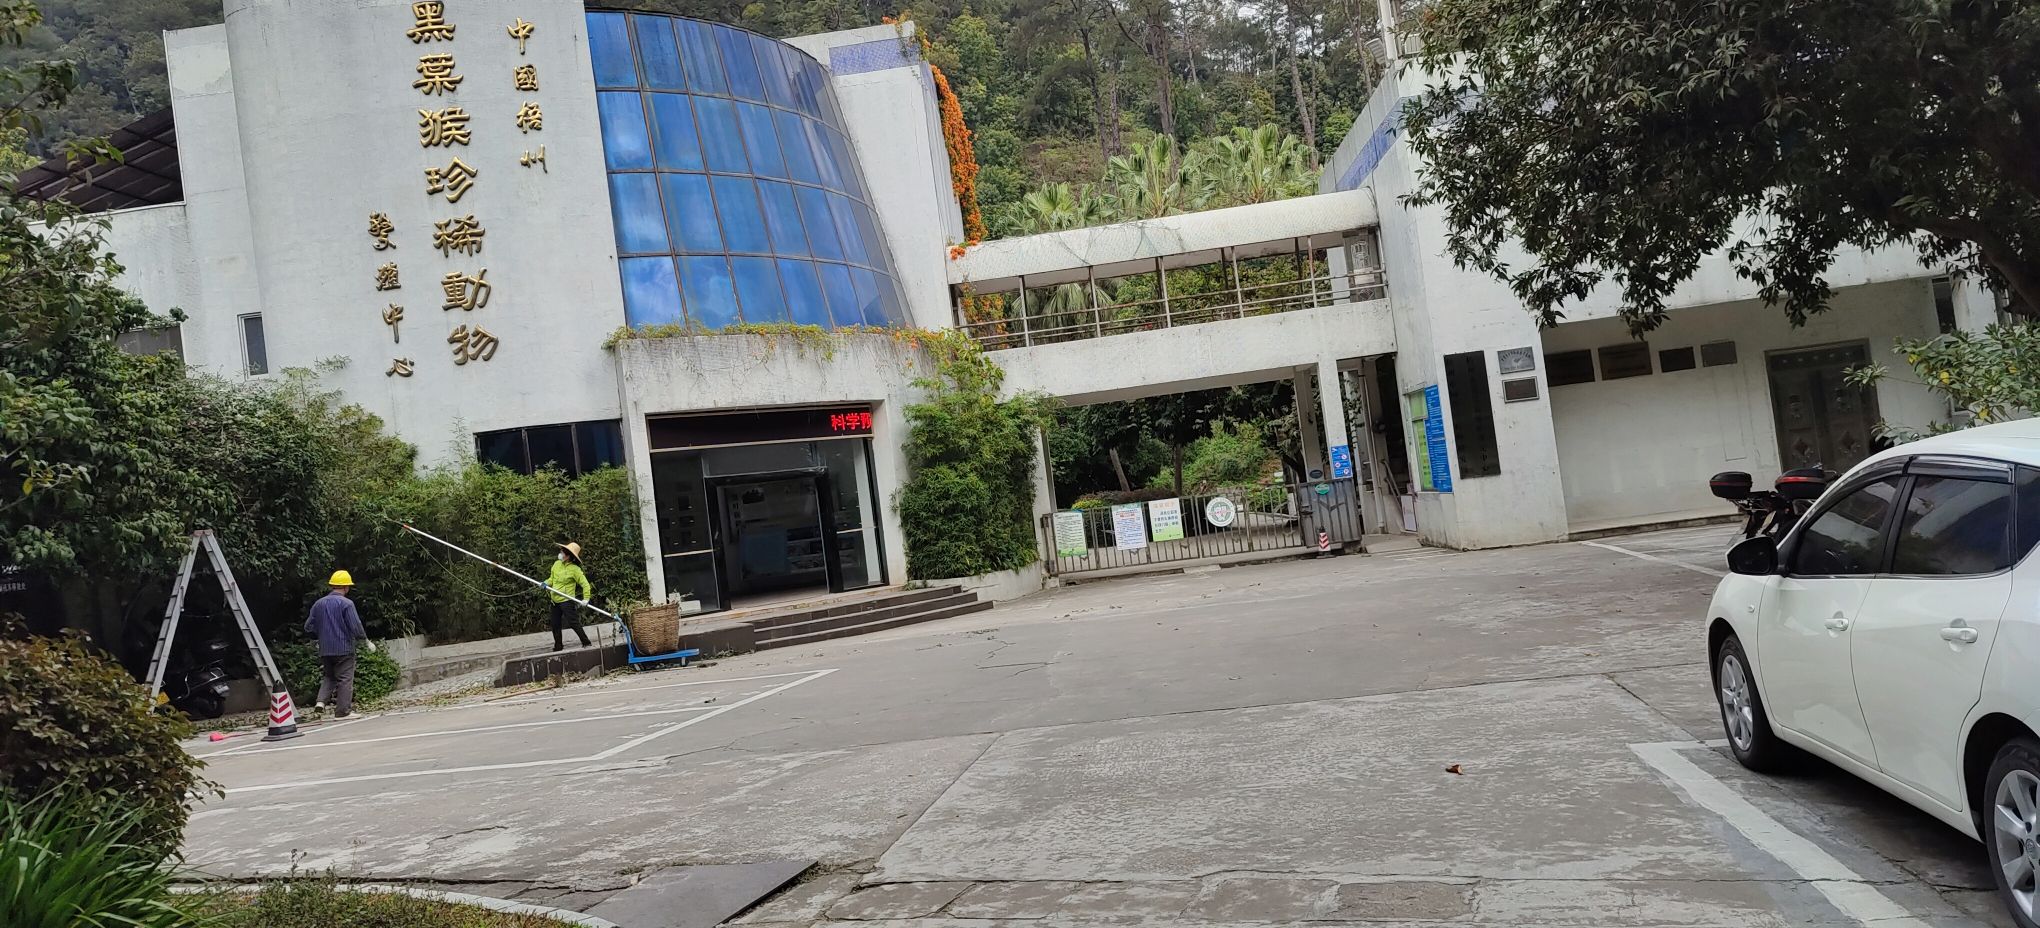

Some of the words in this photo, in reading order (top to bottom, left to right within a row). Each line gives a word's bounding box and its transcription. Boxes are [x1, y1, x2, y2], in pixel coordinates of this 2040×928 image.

[406, 0, 499, 366] 黑葉猴珍稀動物
[507, 16, 548, 174] 中國梧州
